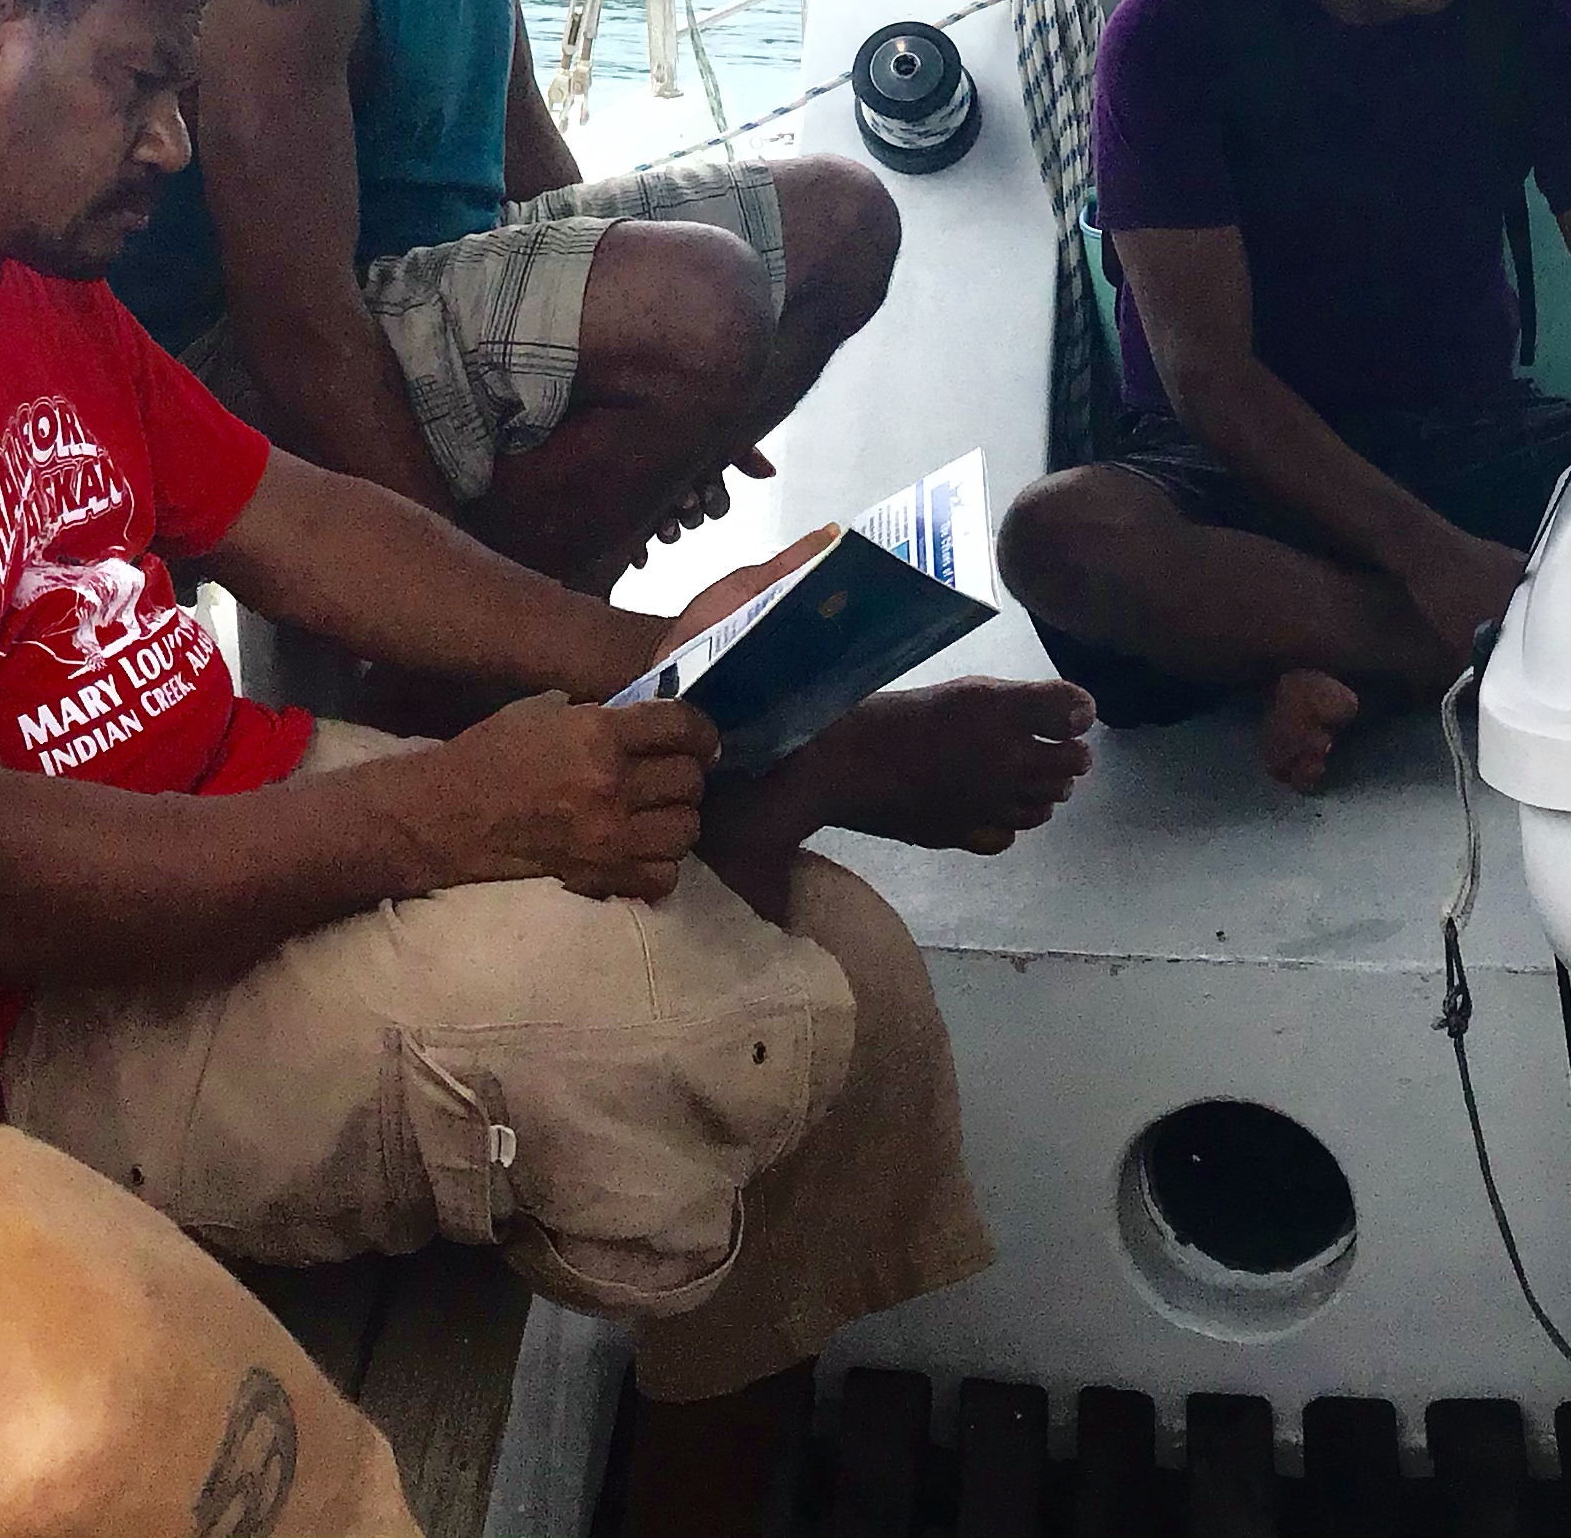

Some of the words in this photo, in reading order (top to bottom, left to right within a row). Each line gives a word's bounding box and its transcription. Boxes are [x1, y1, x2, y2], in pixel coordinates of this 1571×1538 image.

[17, 674, 123, 751] MARY
[38, 709, 144, 777] INDIAN
[140, 671, 197, 718] CREEK,
